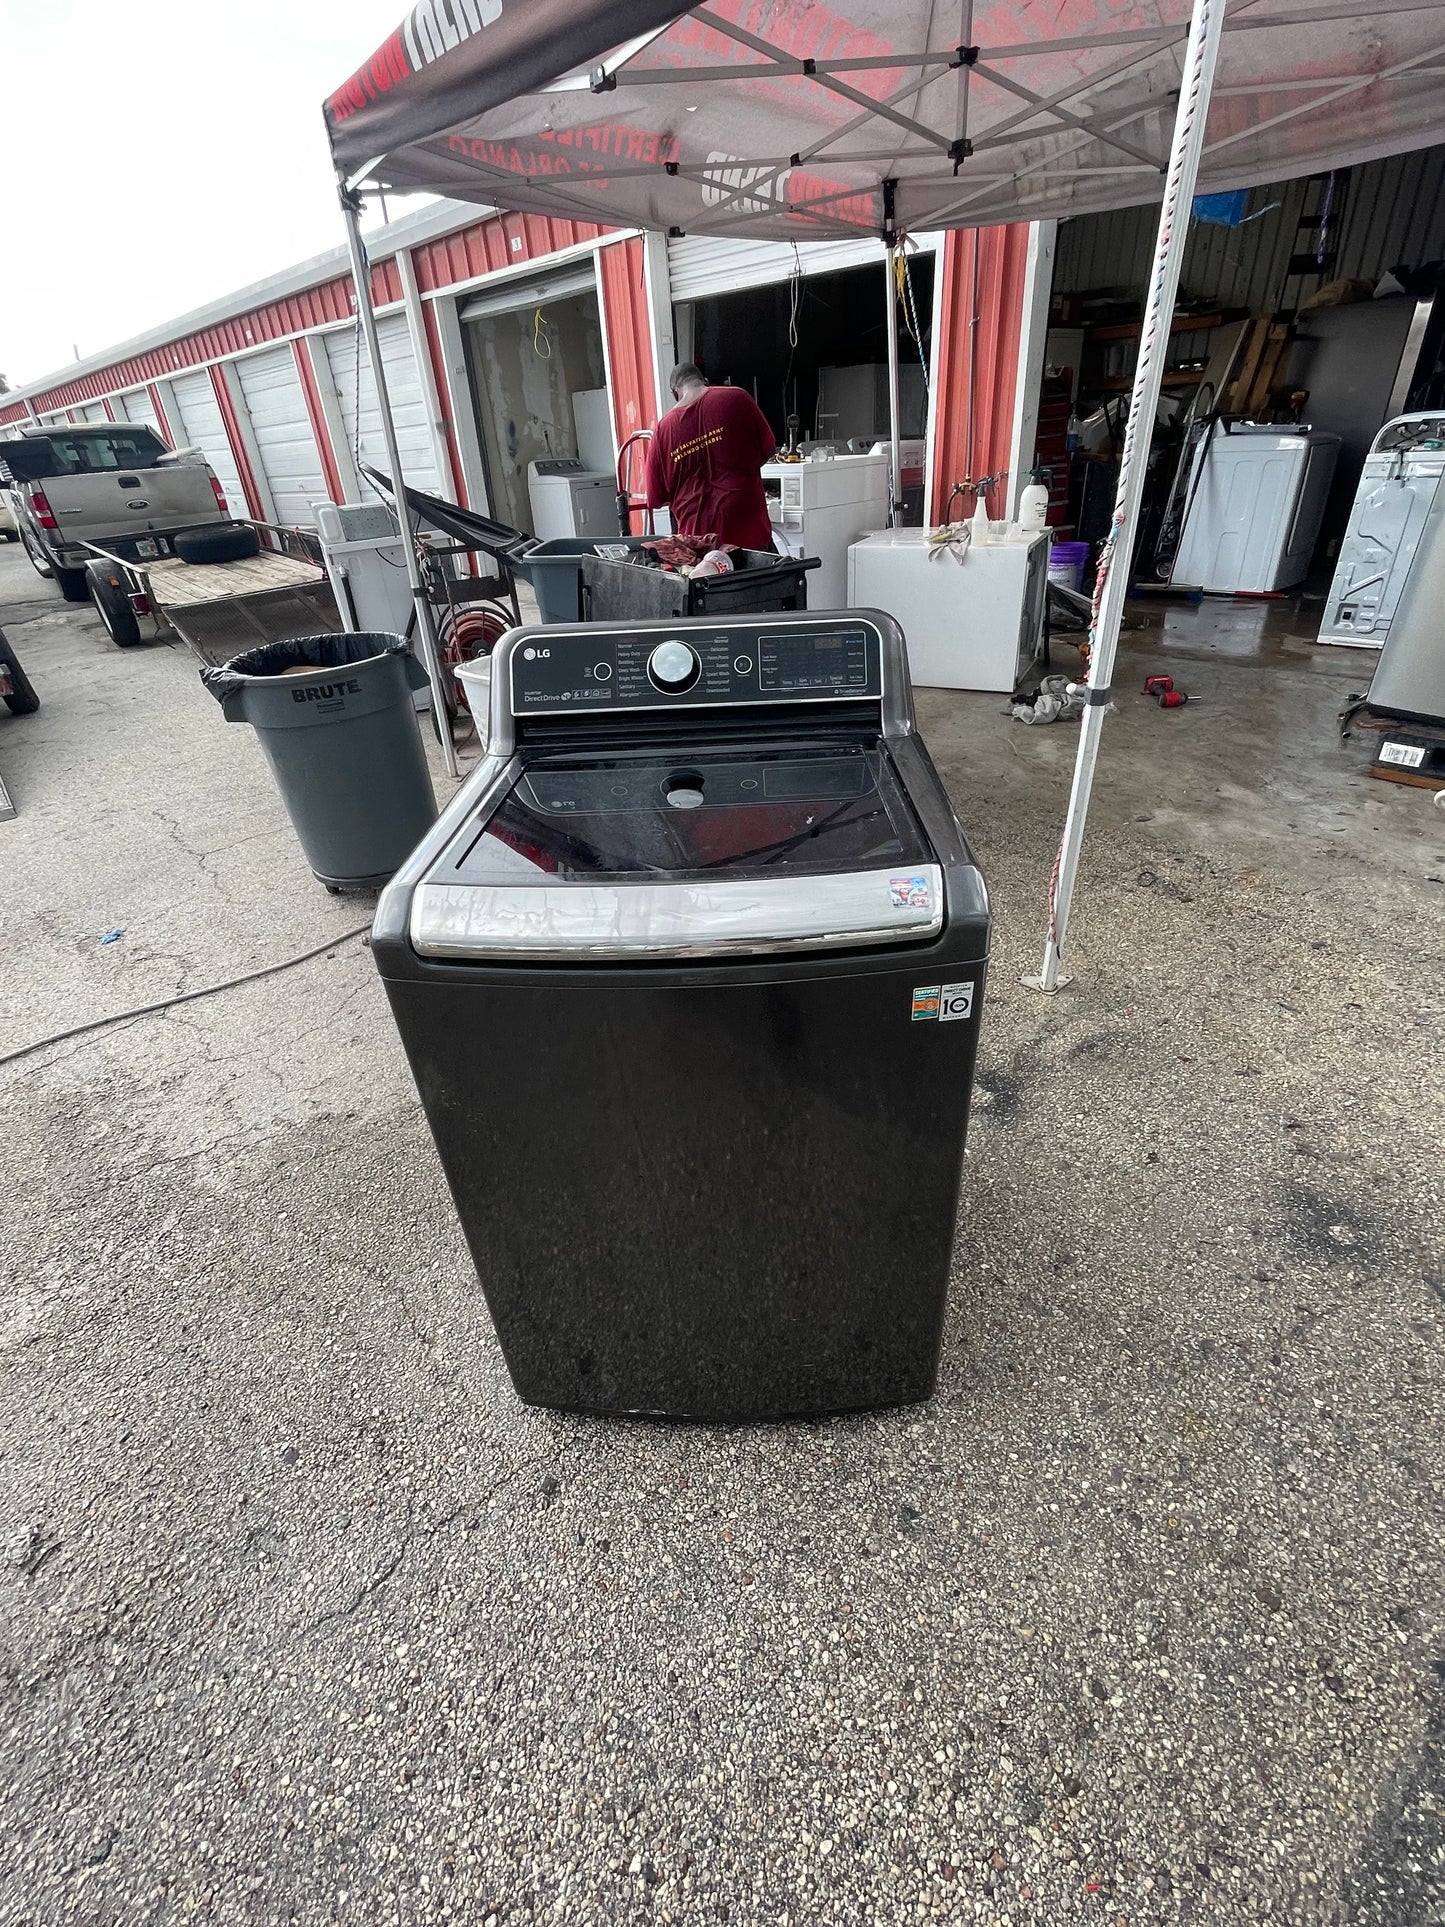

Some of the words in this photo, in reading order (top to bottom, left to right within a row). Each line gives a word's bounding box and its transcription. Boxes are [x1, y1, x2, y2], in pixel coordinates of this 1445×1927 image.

[537, 649, 551, 658] LG
[292, 679, 361, 703] BRUTE
[943, 996, 969, 1015] 10
